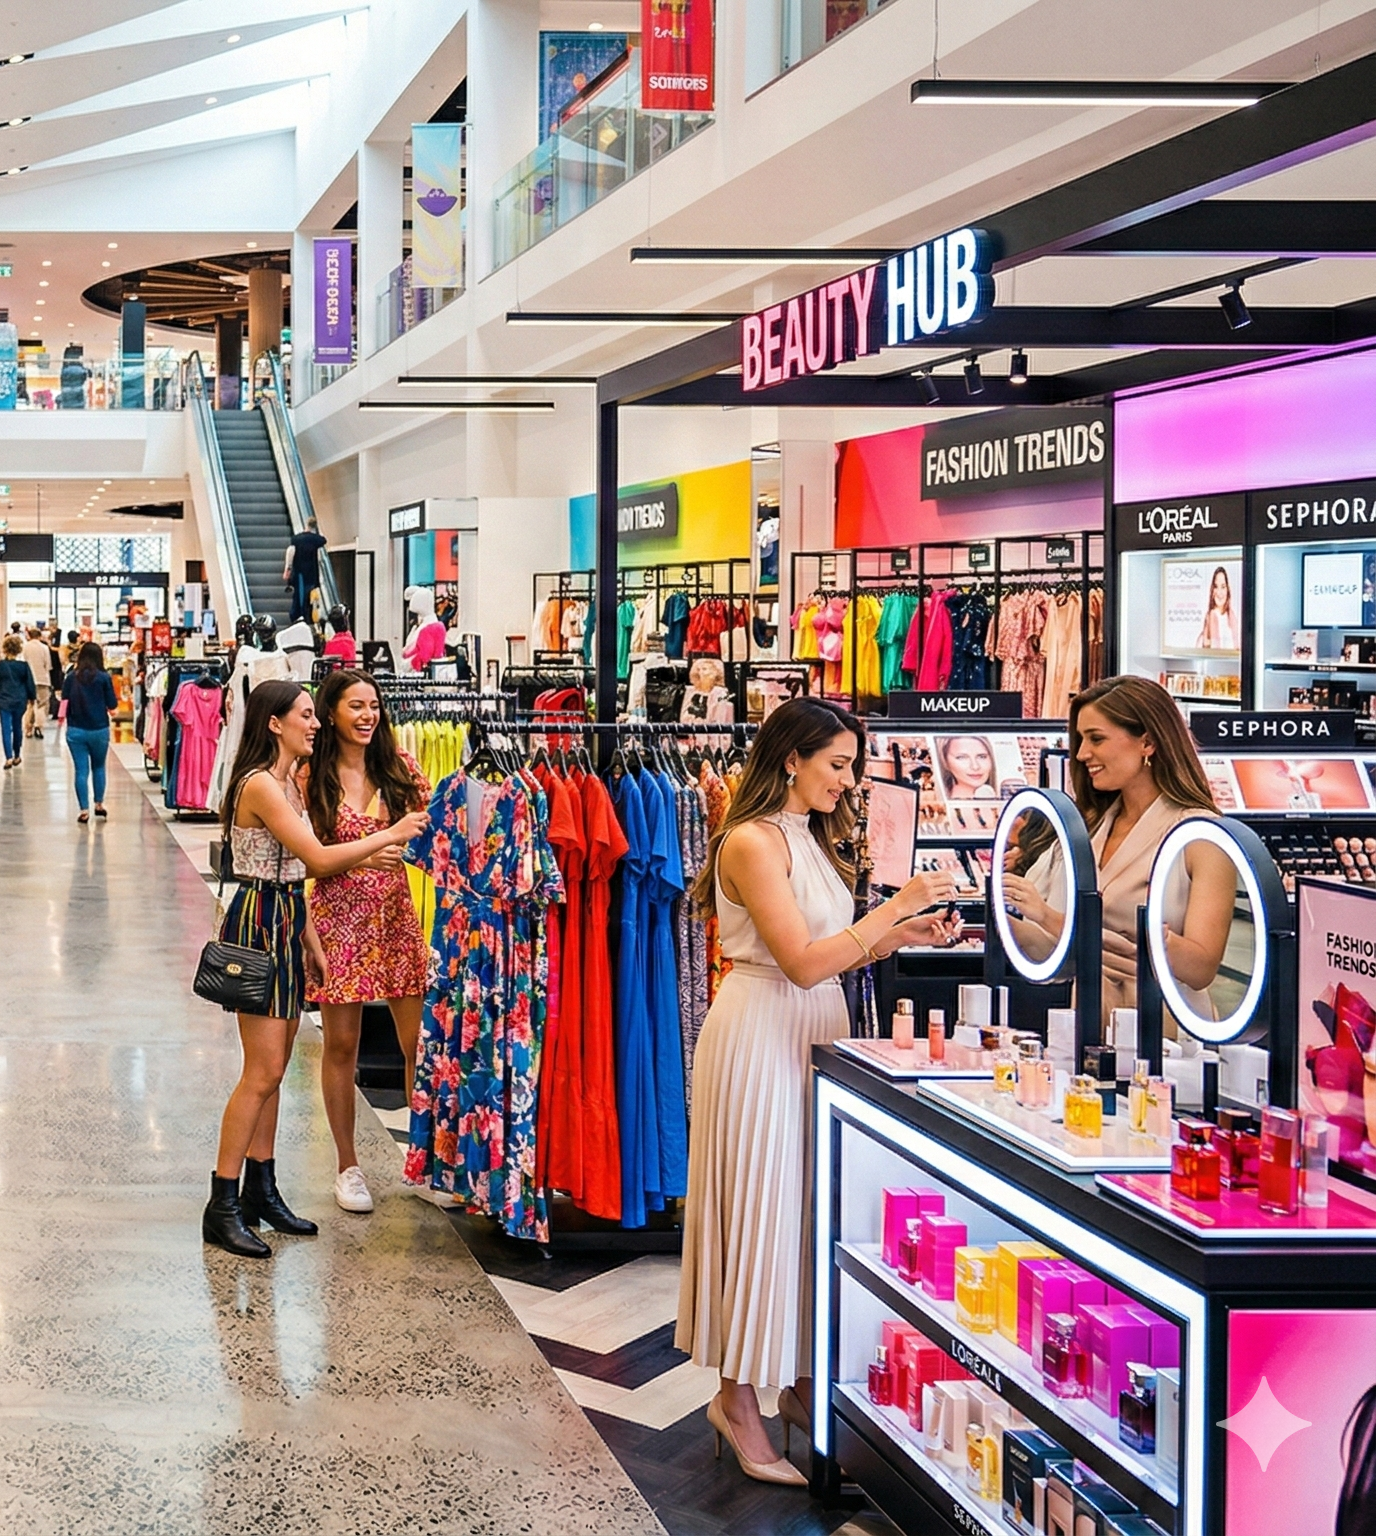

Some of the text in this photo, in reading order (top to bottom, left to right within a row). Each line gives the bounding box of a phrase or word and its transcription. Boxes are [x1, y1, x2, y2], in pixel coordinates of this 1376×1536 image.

[742, 228, 982, 391] BEAUTY HUB
[926, 420, 1105, 486] FASHION TRENDS
[1138, 505, 1218, 534] L'ORÉAL
[1162, 531, 1193, 544] PARIS
[920, 698, 991, 712] MAKEUP
[1218, 720, 1331, 737] SEPHORA
[1326, 931, 1376, 959] FASHIO
